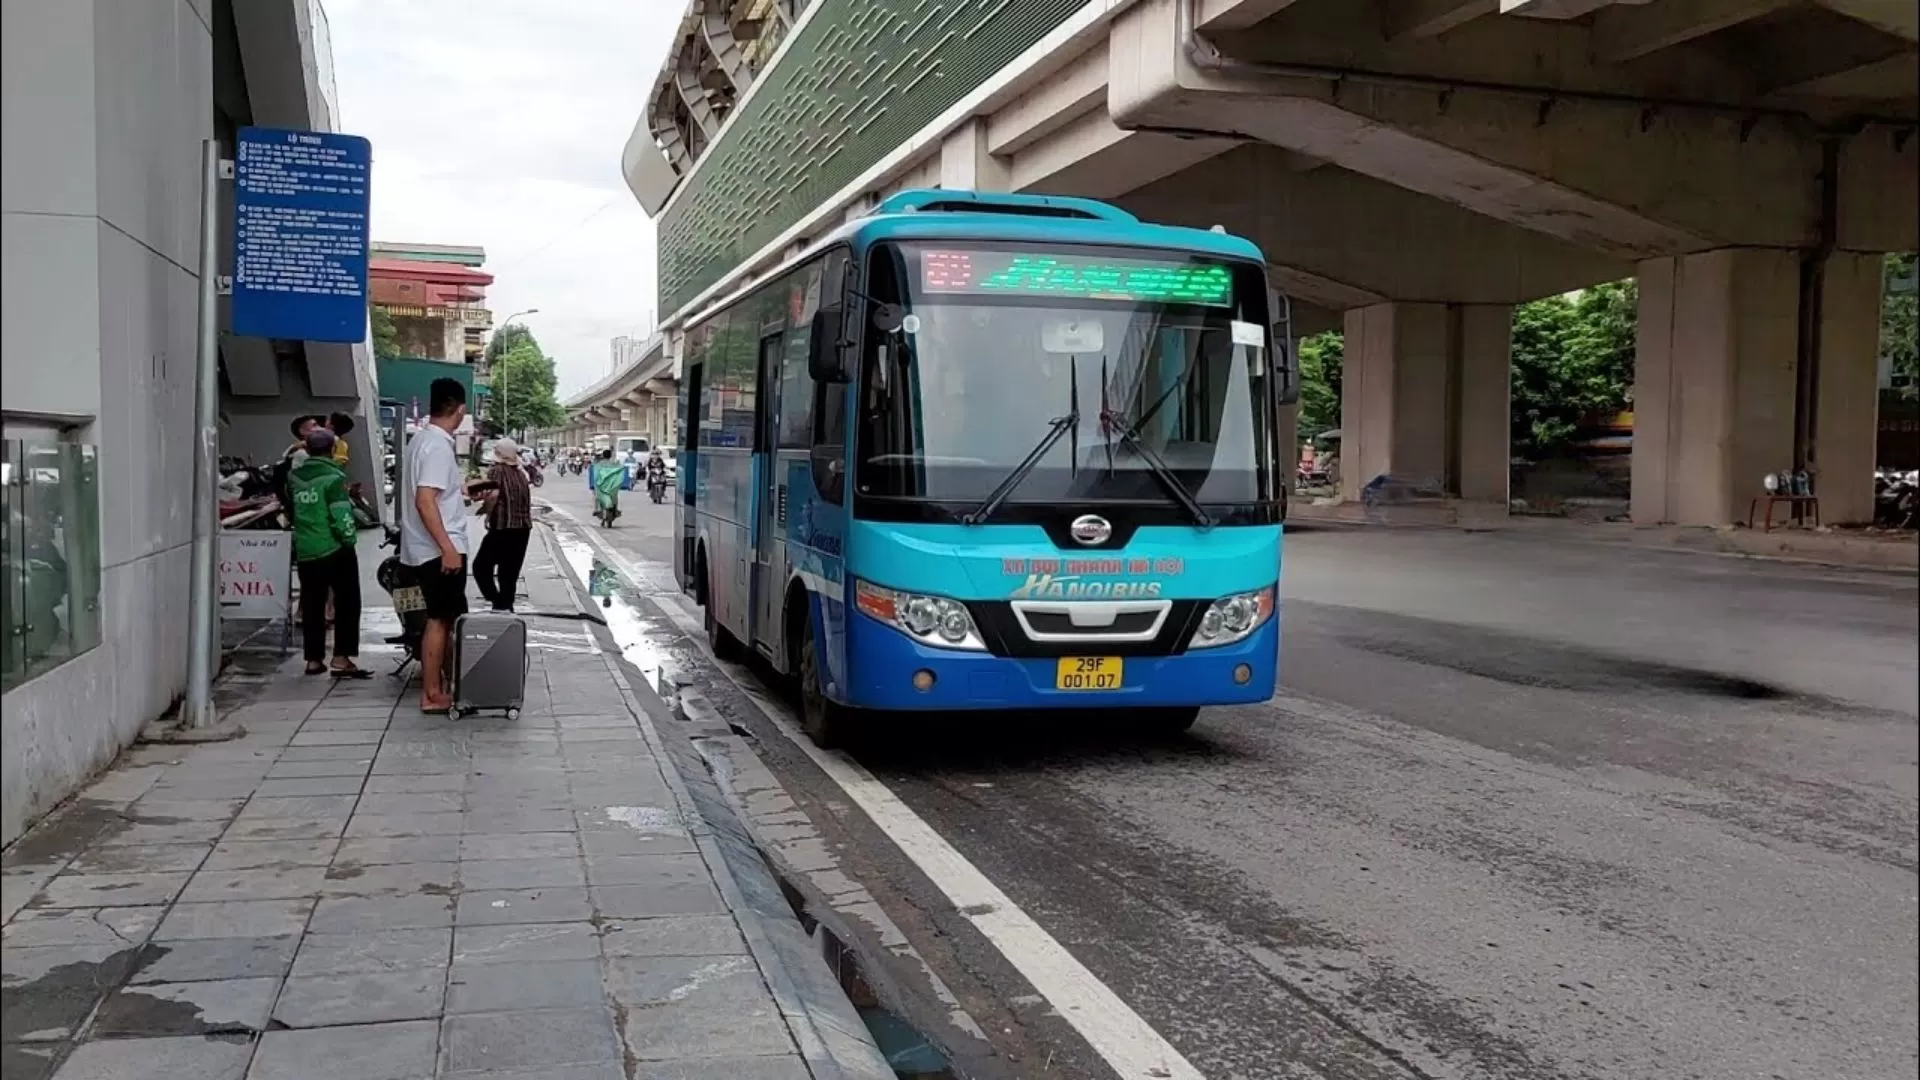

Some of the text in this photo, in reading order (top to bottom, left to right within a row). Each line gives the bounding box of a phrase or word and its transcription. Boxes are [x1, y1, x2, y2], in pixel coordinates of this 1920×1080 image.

[219, 560, 258, 573] G XE
[233, 577, 274, 596] NHÀ
[1076, 657, 1105, 672] 29F
[1063, 673, 1115, 689] 001.07
